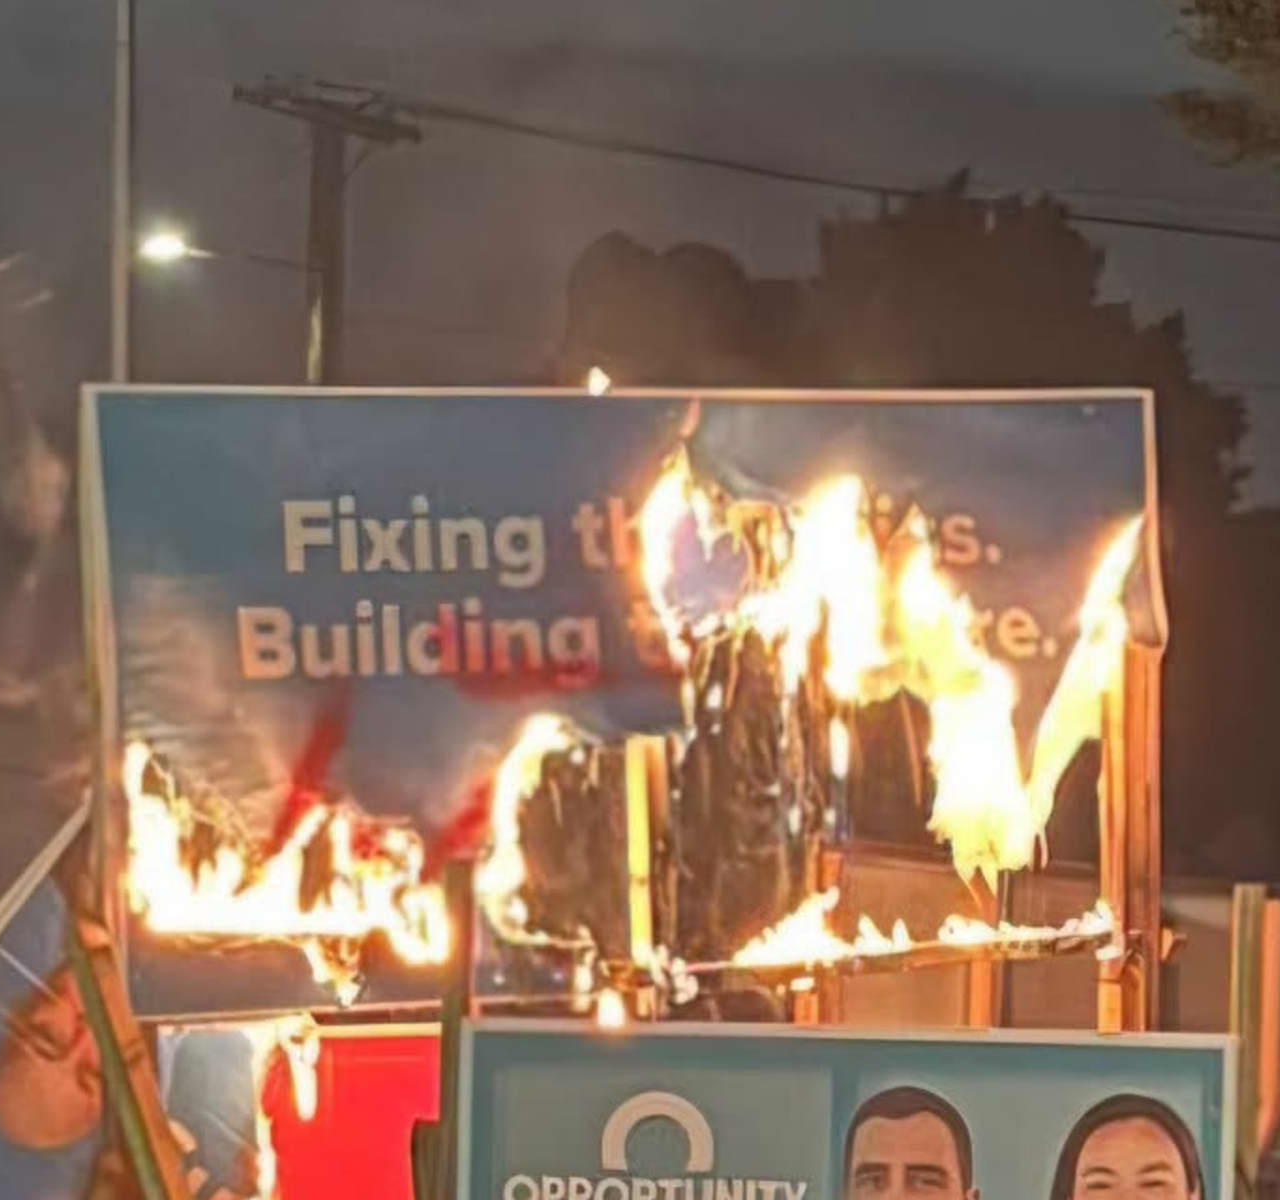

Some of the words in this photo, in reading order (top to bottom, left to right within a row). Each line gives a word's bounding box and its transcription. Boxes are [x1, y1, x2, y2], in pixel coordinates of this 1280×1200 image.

[282, 495, 546, 588] Fixing
[572, 497, 642, 570] th
[237, 600, 601, 688] Building
